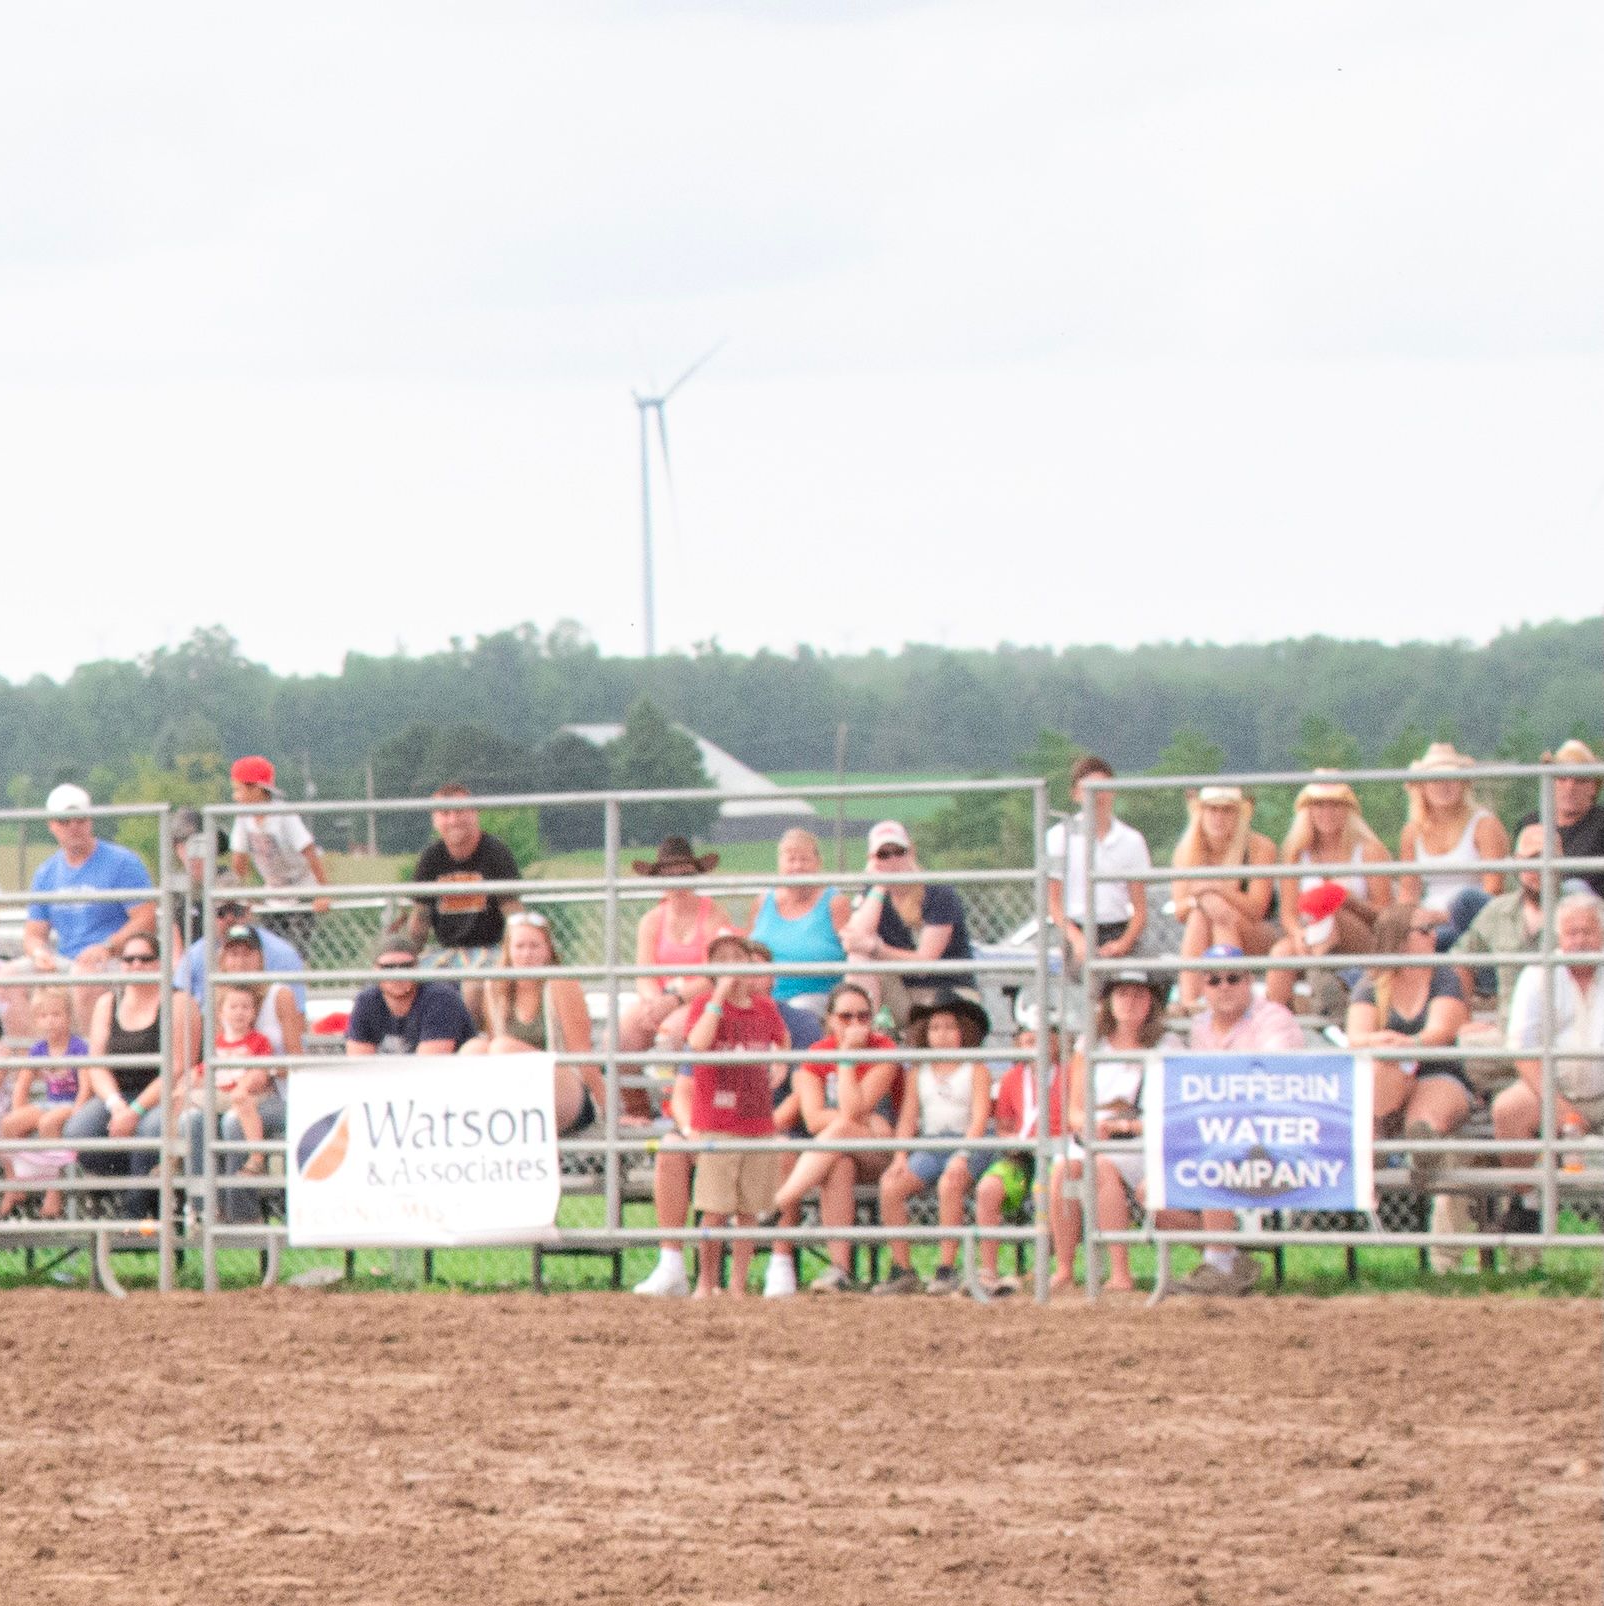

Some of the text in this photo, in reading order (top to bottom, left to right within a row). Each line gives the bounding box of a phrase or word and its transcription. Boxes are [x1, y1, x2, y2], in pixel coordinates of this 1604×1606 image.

[1180, 1073, 1340, 1102] DUFFERIN
[362, 1099, 547, 1149] Watson
[1197, 1115, 1320, 1144] WATER
[366, 1155, 549, 1187] & Associates
[1174, 1159, 1344, 1188] COMPANY
